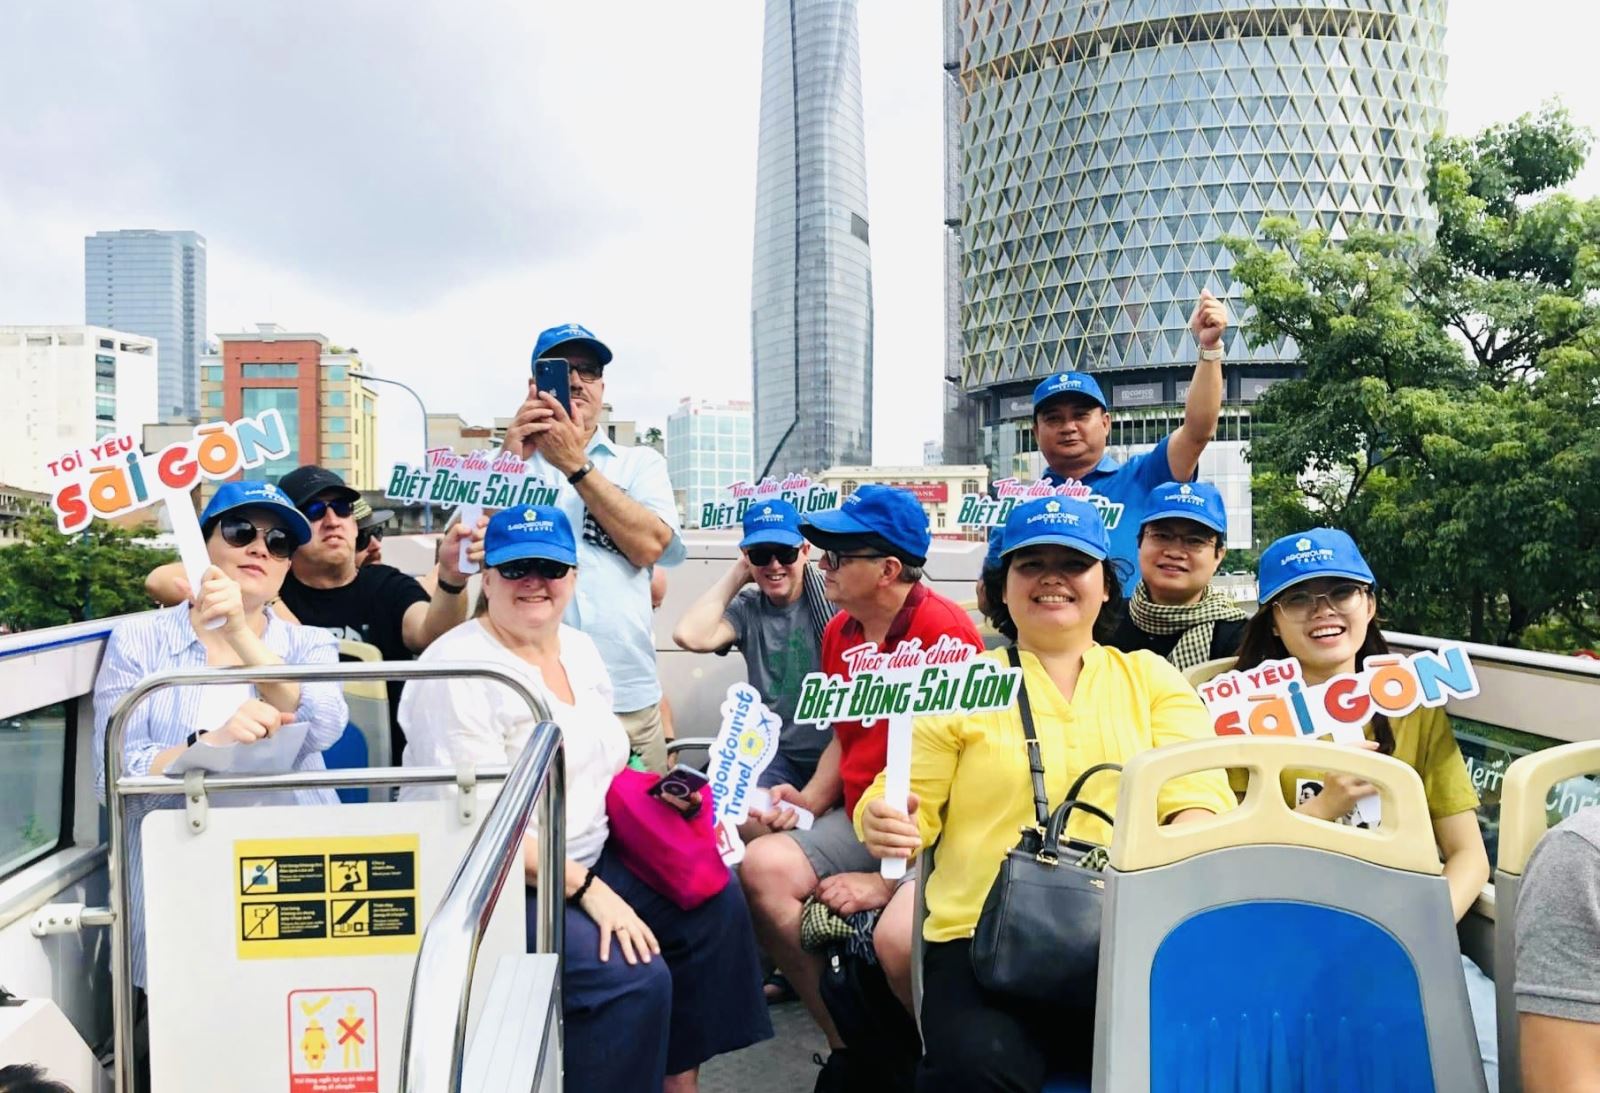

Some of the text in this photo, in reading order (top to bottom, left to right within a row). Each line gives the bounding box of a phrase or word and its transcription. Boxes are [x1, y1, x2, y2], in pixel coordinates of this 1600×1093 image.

[90, 436, 133, 460] YÊU
[427, 447, 458, 469] Theo
[491, 454, 526, 474] chân
[388, 465, 559, 507] BIỆT ĐỘNG SÀI GÒN
[727, 481, 754, 497] Theo
[781, 474, 808, 490] chân
[995, 479, 1024, 497] Theo
[1055, 480, 1089, 497] chân
[701, 502, 734, 528] BIỆT
[806, 487, 838, 513] GÒN
[958, 497, 998, 529] BIỆT
[1043, 518, 1080, 527] TRAVEL
[846, 638, 969, 673] Theo dấu chân
[1248, 663, 1295, 689] YÊU
[797, 663, 1017, 726] BIỆT ĐỘNG SÀI GÒN
[712, 689, 754, 827] igontourist
[724, 761, 753, 816] Travel
